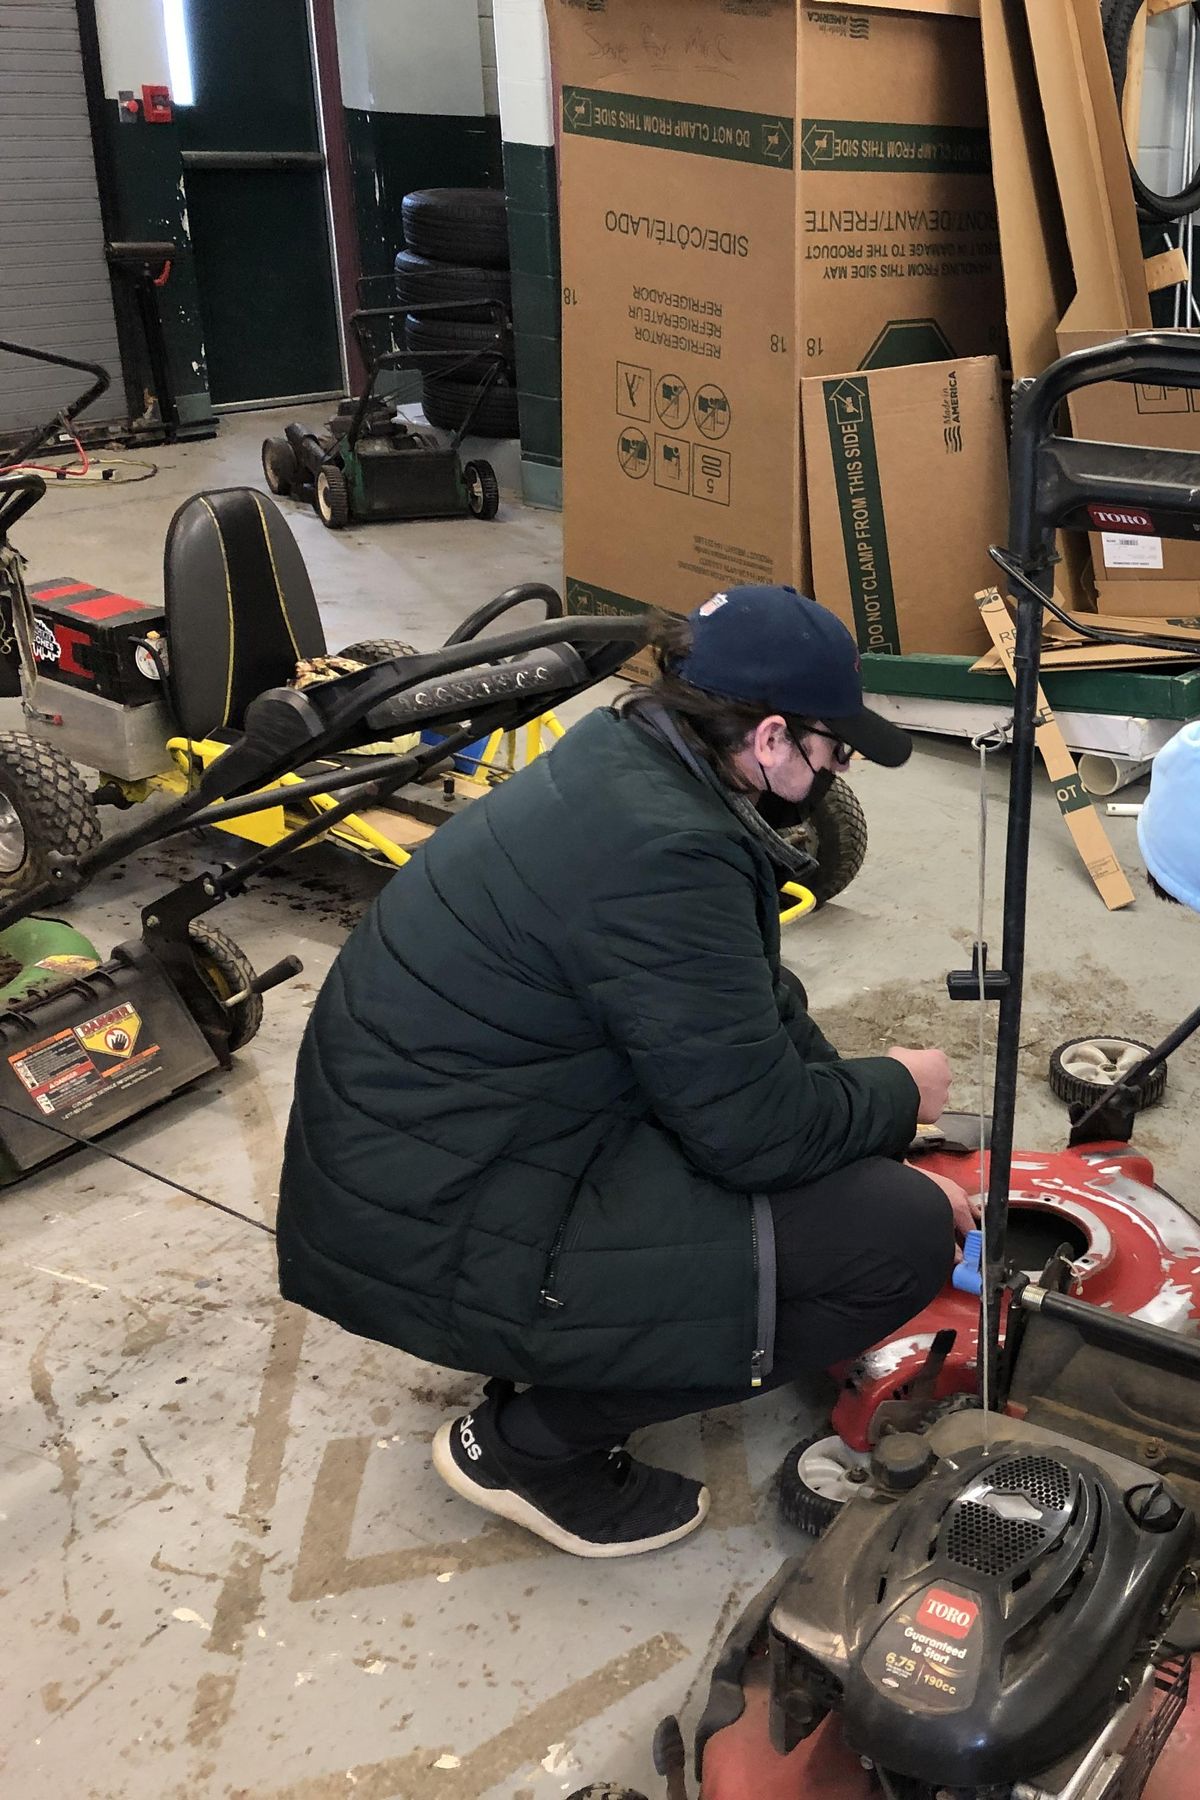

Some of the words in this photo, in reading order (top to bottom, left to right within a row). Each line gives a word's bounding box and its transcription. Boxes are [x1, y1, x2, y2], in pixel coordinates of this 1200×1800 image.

[808, 11, 848, 25] AMERICA
[594, 107, 616, 126] SIDE
[620, 110, 641, 131] THIS
[644, 116, 672, 136] FROM
[674, 120, 710, 141] CLAMP
[712, 126, 733, 144] NOT
[735, 129, 750, 148] DO
[834, 138, 859, 157] SIDE
[861, 139, 884, 158] THIS
[887, 141, 914, 159] FROM
[805, 245, 862, 260] PRODUCT
[867, 244, 888, 258] THE
[891, 244, 906, 257] TO
[823, 265, 847, 279] MAY
[851, 264, 876, 279] SIDE
[880, 264, 904, 278] THIS
[908, 263, 938, 277] FROM
[564, 287, 578, 306] 18
[633, 285, 722, 317] REFRIGERADOR
[635, 327, 721, 359] REFRIGERATOR
[770, 334, 787, 353] 18
[806, 338, 824, 357] 18
[948, 371, 961, 423] AMERICA
[841, 421, 861, 458] SIDE
[706, 478, 714, 494] 5
[846, 461, 865, 495] THIS
[851, 498, 871, 538] FROM
[1094, 511, 1148, 526] TORO
[857, 542, 878, 590] CLAMP
[864, 594, 881, 623] NOT
[868, 624, 885, 645] DO
[1056, 784, 1077, 802] OT
[81, 1006, 130, 1034] DANGER
[926, 1599, 971, 1627] TORO
[904, 1627, 967, 1659] Guaranteed
[885, 1652, 916, 1672] 6.75
[911, 1642, 922, 1653] to
[923, 1647, 950, 1665] Start
[924, 1674, 957, 1694] 190cc
